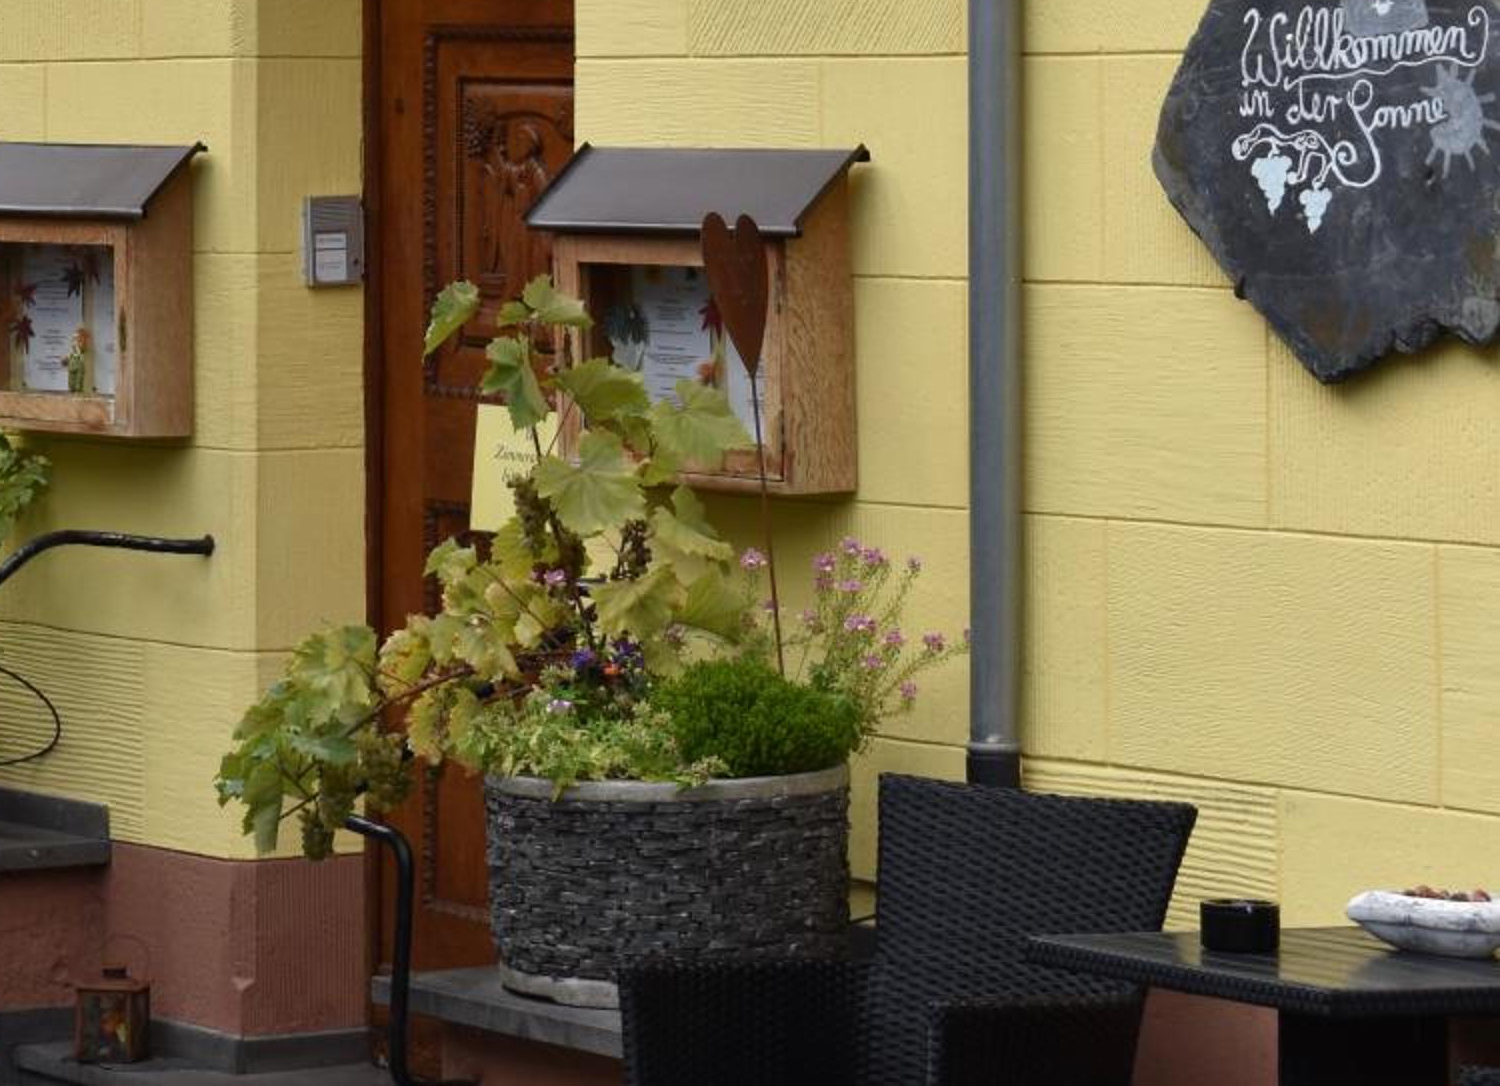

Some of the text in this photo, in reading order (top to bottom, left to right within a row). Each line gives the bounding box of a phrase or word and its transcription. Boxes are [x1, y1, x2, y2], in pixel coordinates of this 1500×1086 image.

[1241, 6, 1488, 86] Willkommen
[1239, 88, 1274, 118] in
[1288, 82, 1341, 124] der
